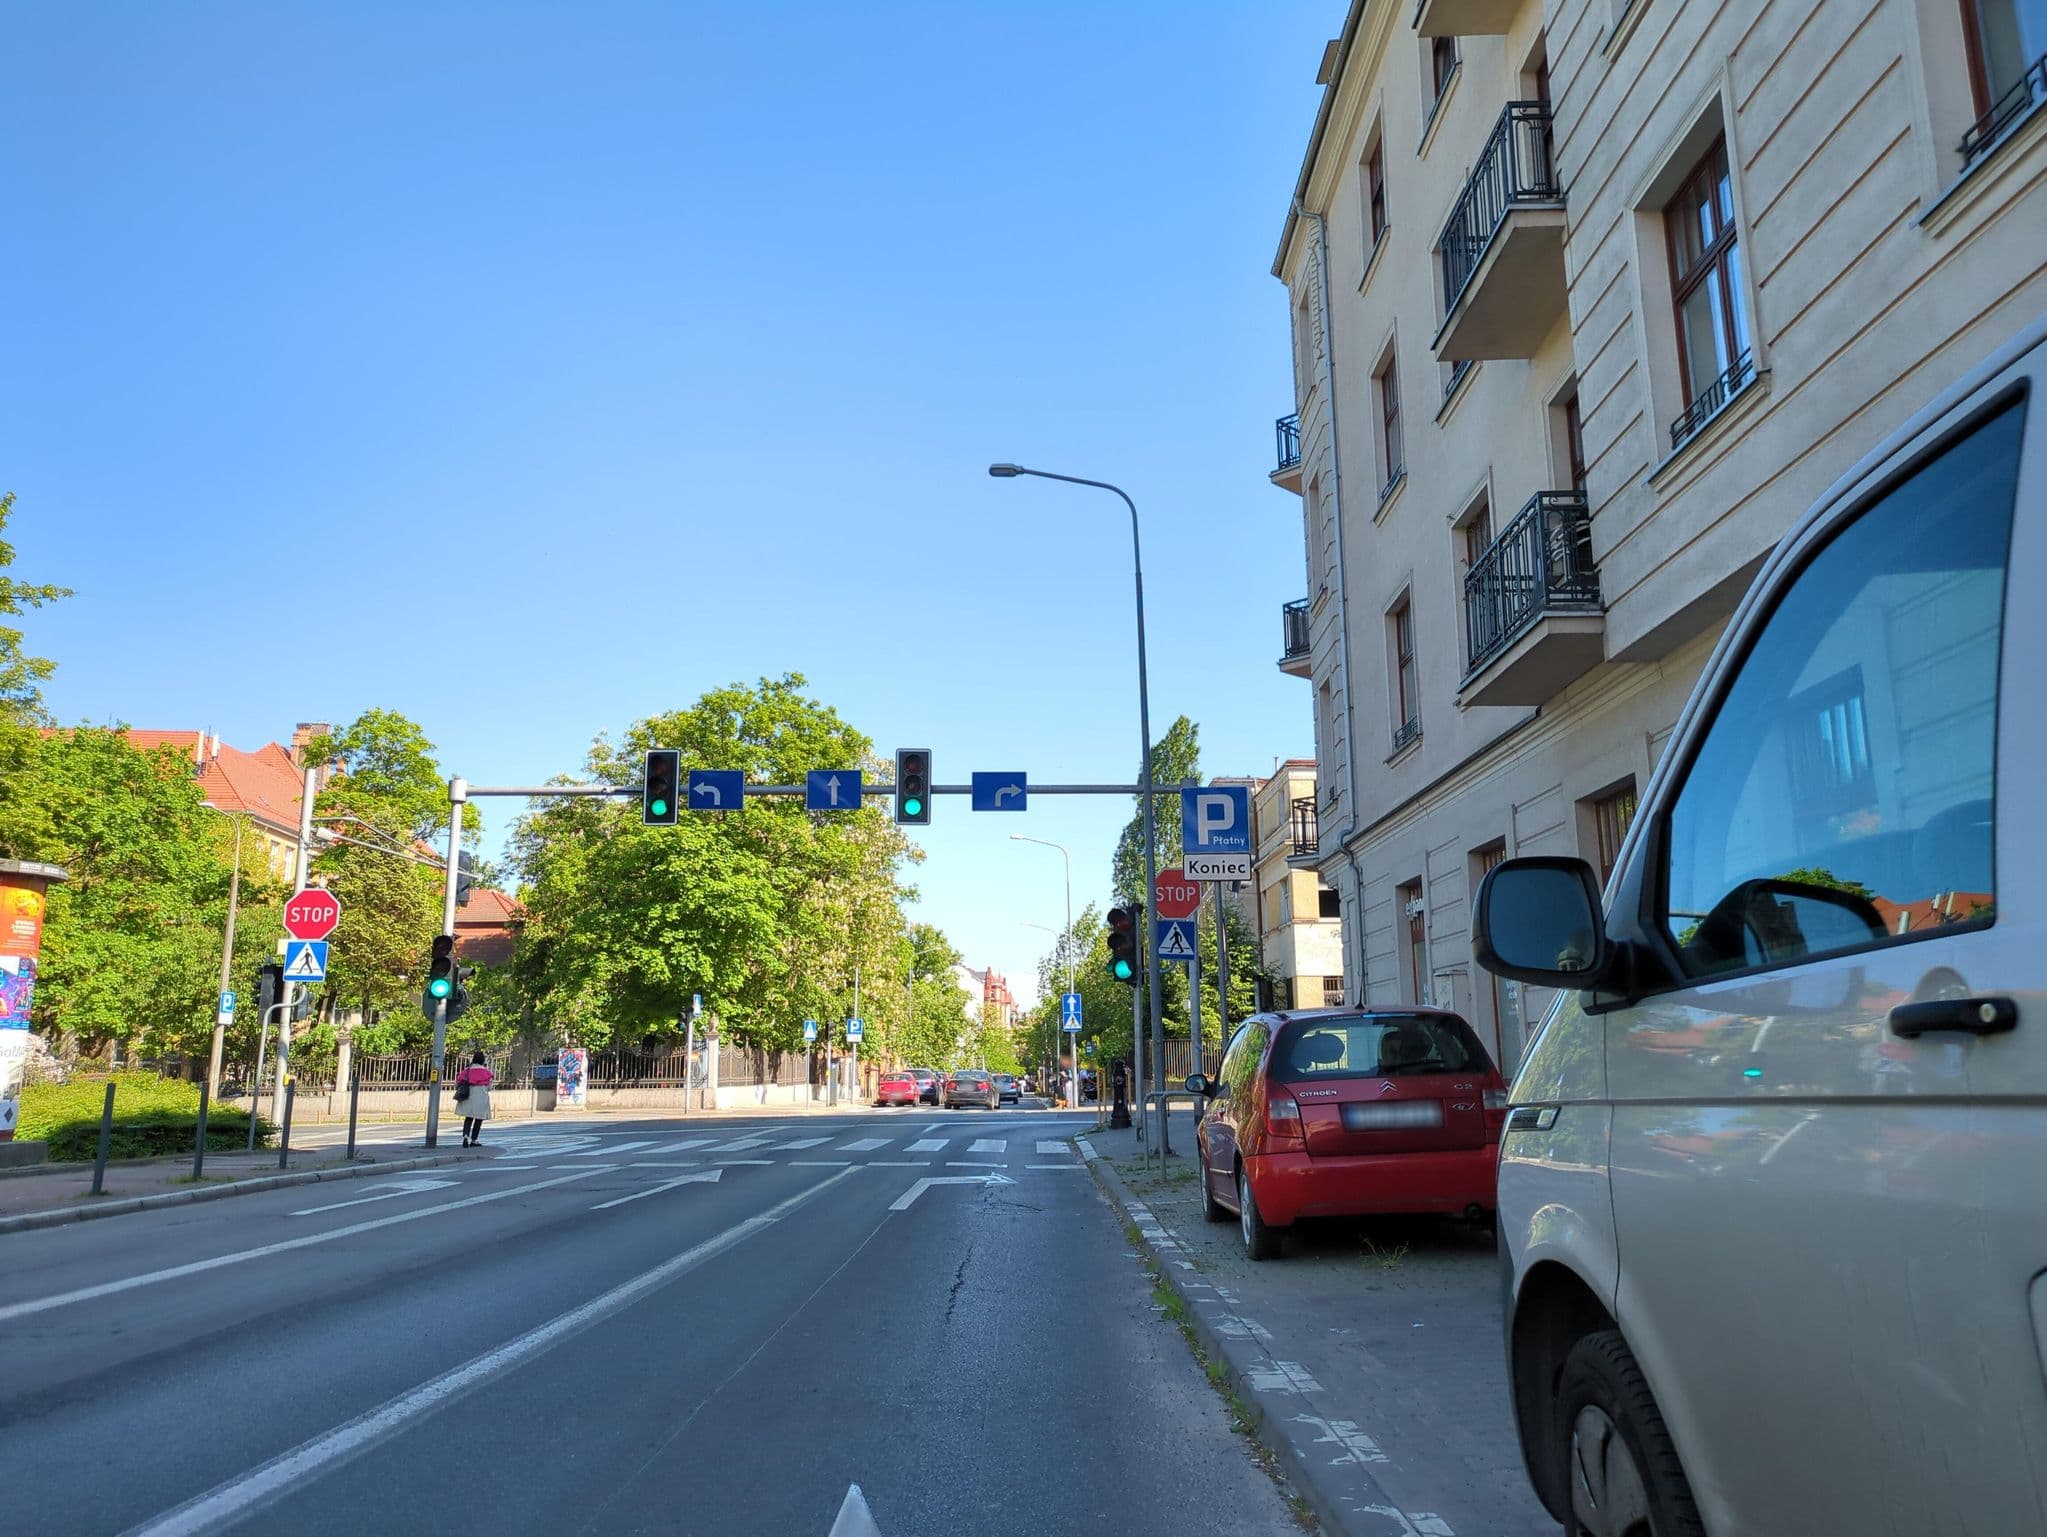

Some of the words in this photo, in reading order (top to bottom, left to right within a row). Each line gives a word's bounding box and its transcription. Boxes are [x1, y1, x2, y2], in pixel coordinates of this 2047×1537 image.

[1197, 794, 1235, 845] P
[1213, 836, 1246, 847] Płatny
[1189, 860, 1246, 874] Koniec
[1156, 886, 1196, 902] STOP
[290, 907, 334, 923] STOP
[850, 1020, 860, 1033] P
